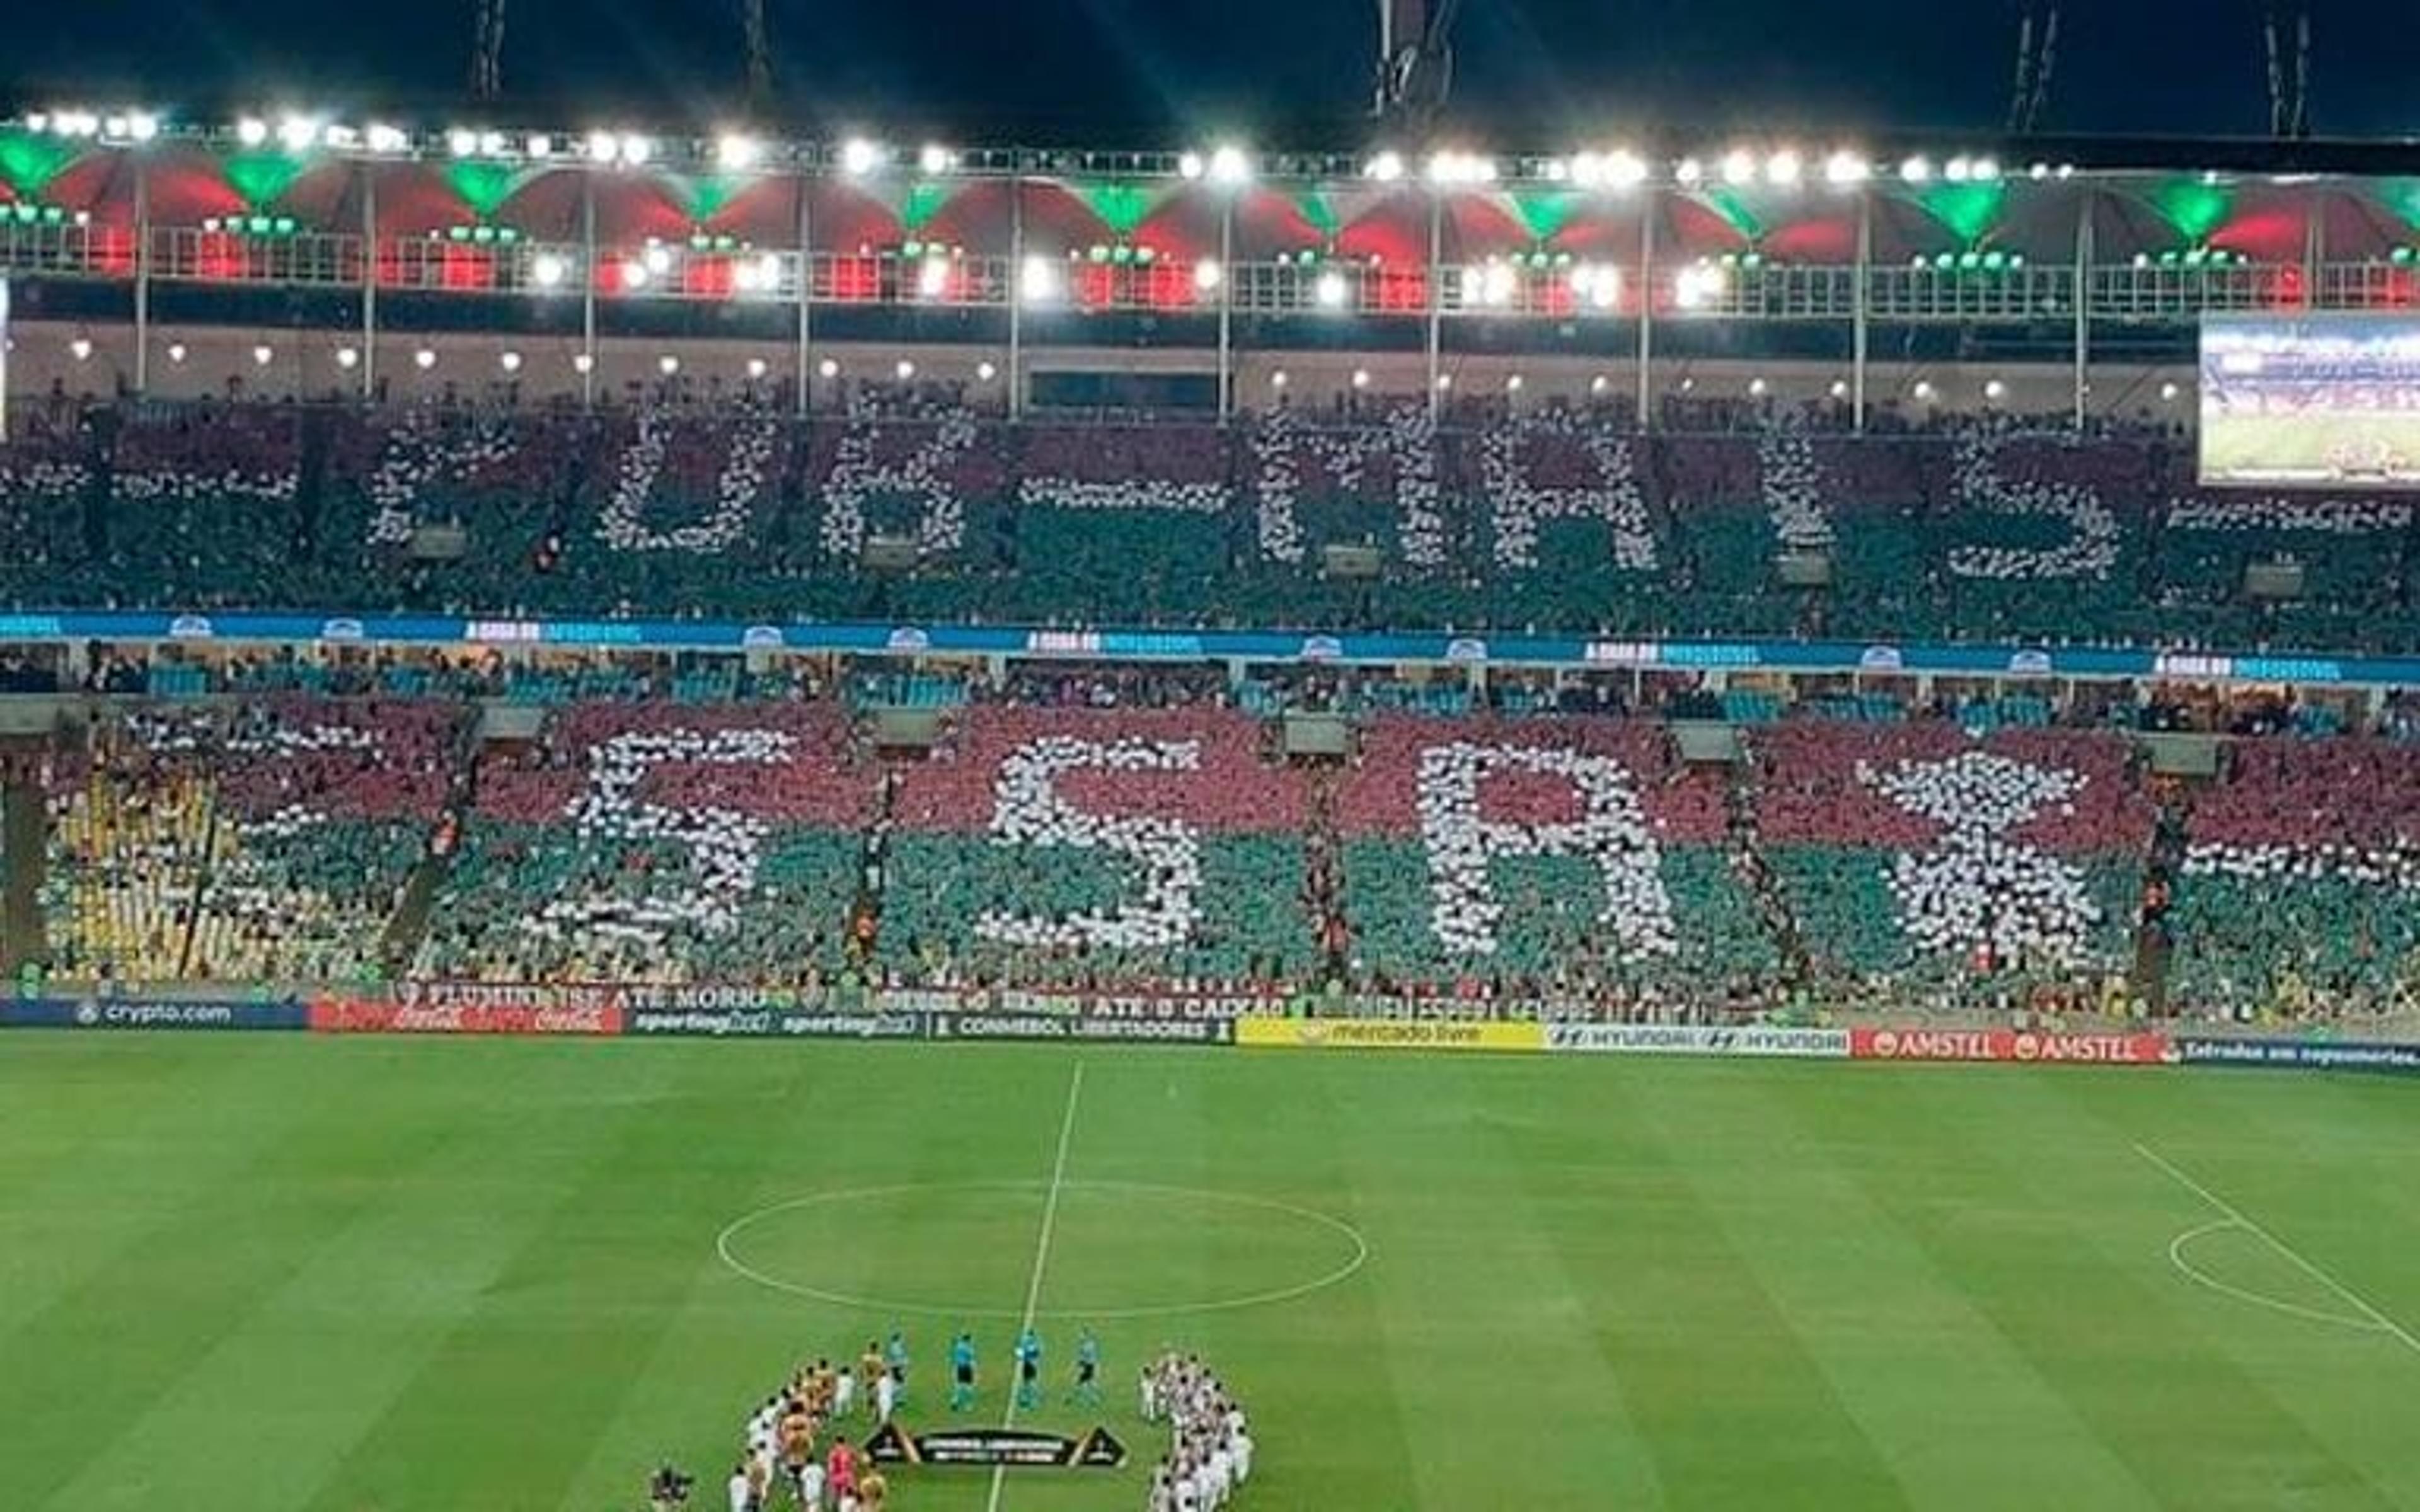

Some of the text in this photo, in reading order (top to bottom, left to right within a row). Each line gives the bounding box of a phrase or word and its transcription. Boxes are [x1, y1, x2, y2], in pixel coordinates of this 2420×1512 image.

[106, 1002, 231, 1025] crypto.com
[1332, 1024, 1482, 1043] mercado livre
[1899, 1034, 2137, 1060] AMSTEL AMSTEL
